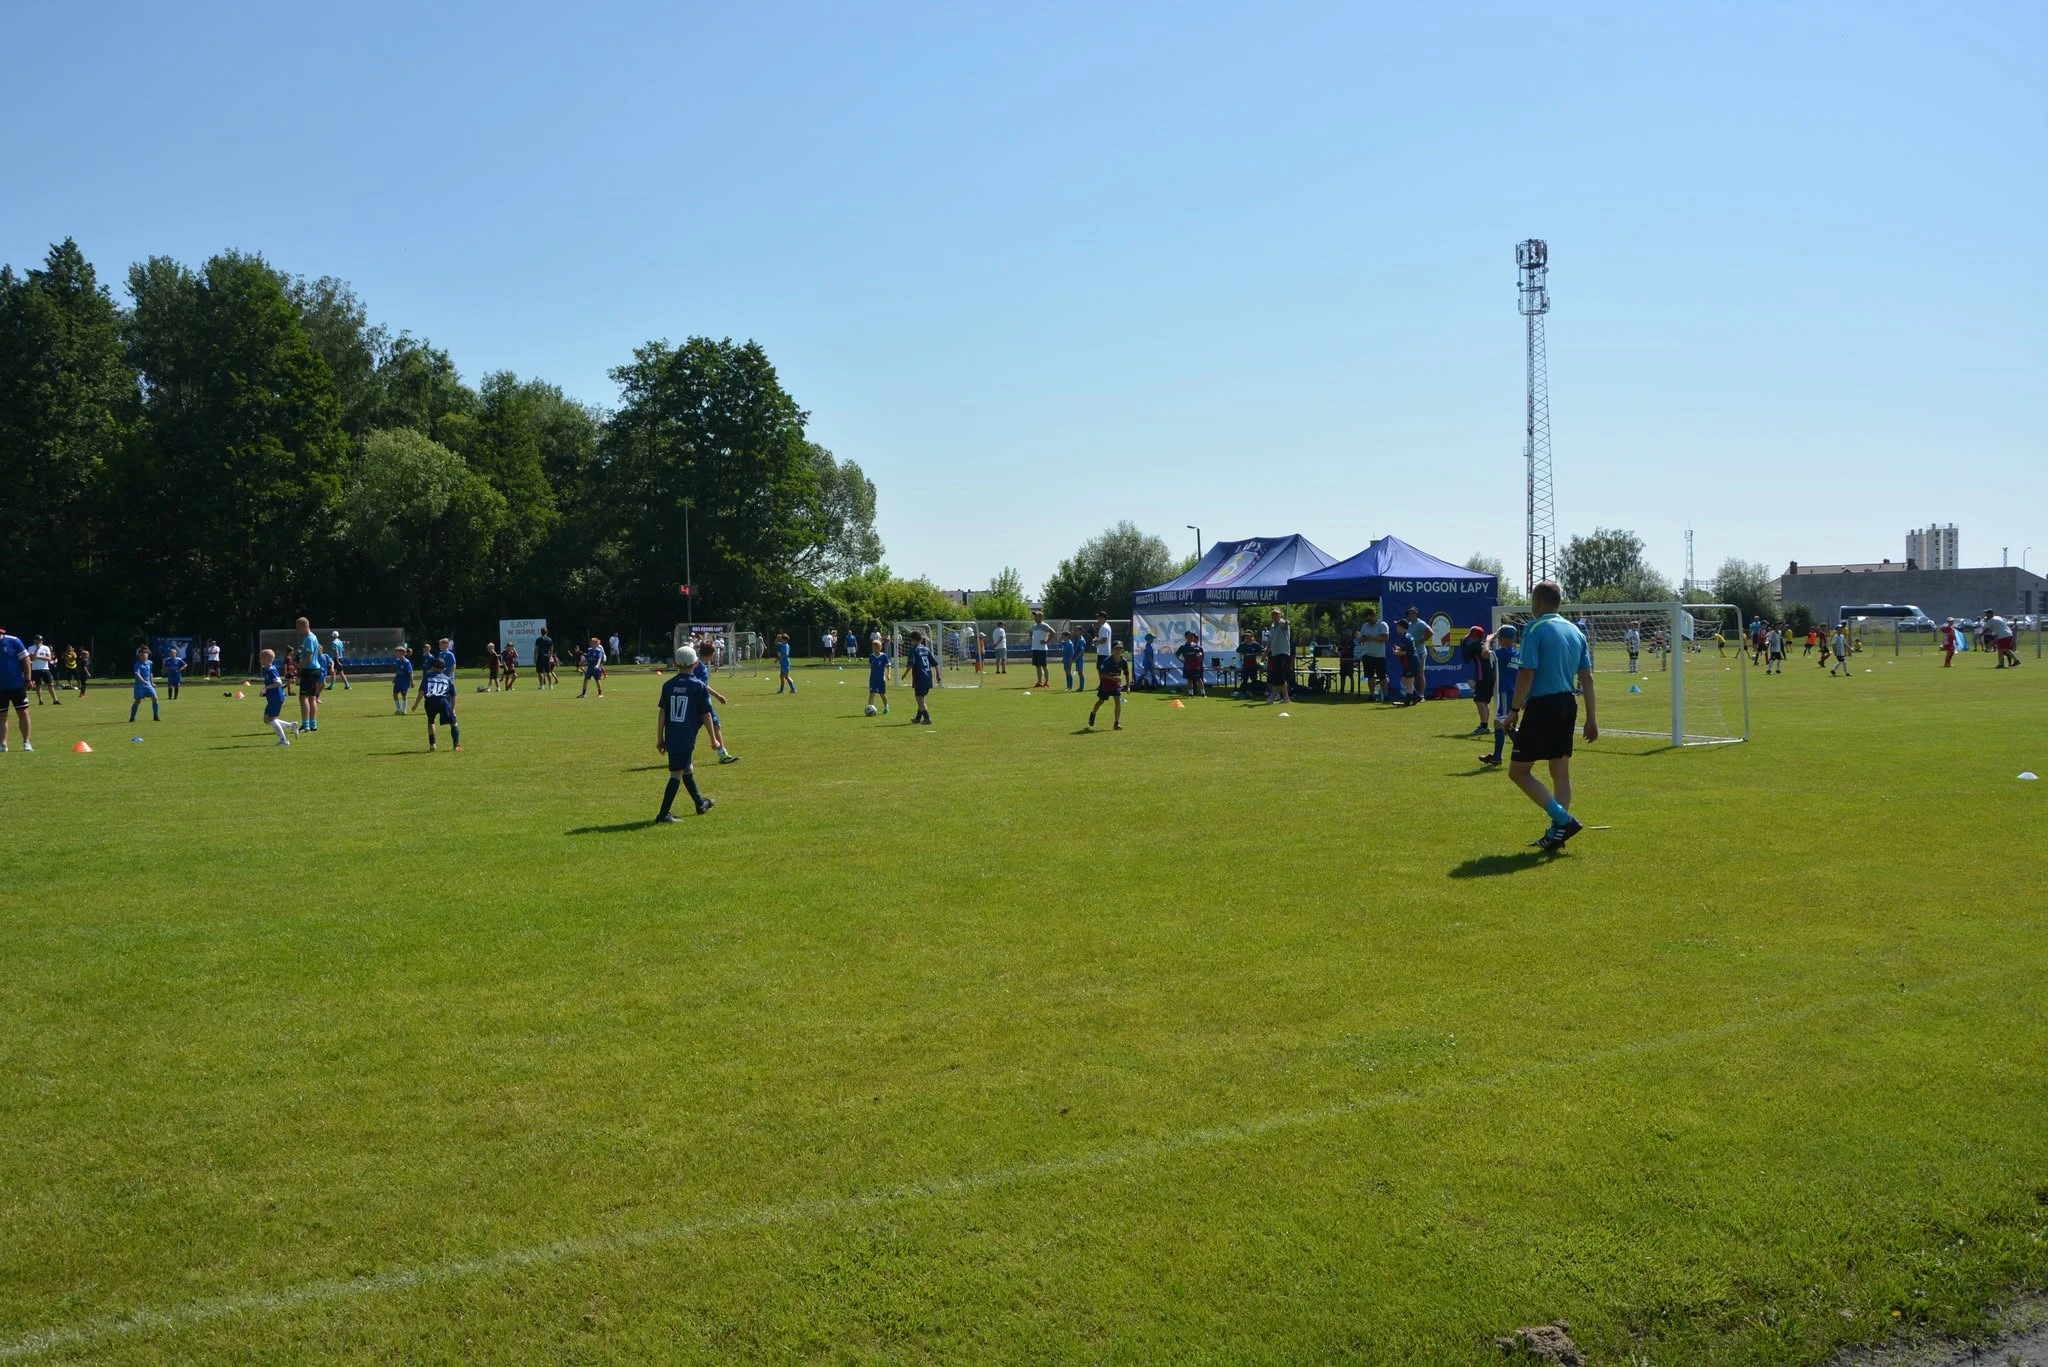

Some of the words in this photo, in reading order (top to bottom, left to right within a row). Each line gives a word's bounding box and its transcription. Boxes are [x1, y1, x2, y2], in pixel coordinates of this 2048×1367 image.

[1388, 581, 1414, 593] MKS
[1416, 579, 1458, 593] POGOŃ
[1460, 582, 1490, 593] ŁAPY
[1205, 589, 1230, 600] MIASTO
[1236, 589, 1259, 600] GMINA
[1260, 589, 1279, 601] ŁAPY
[670, 695, 688, 722] 10
